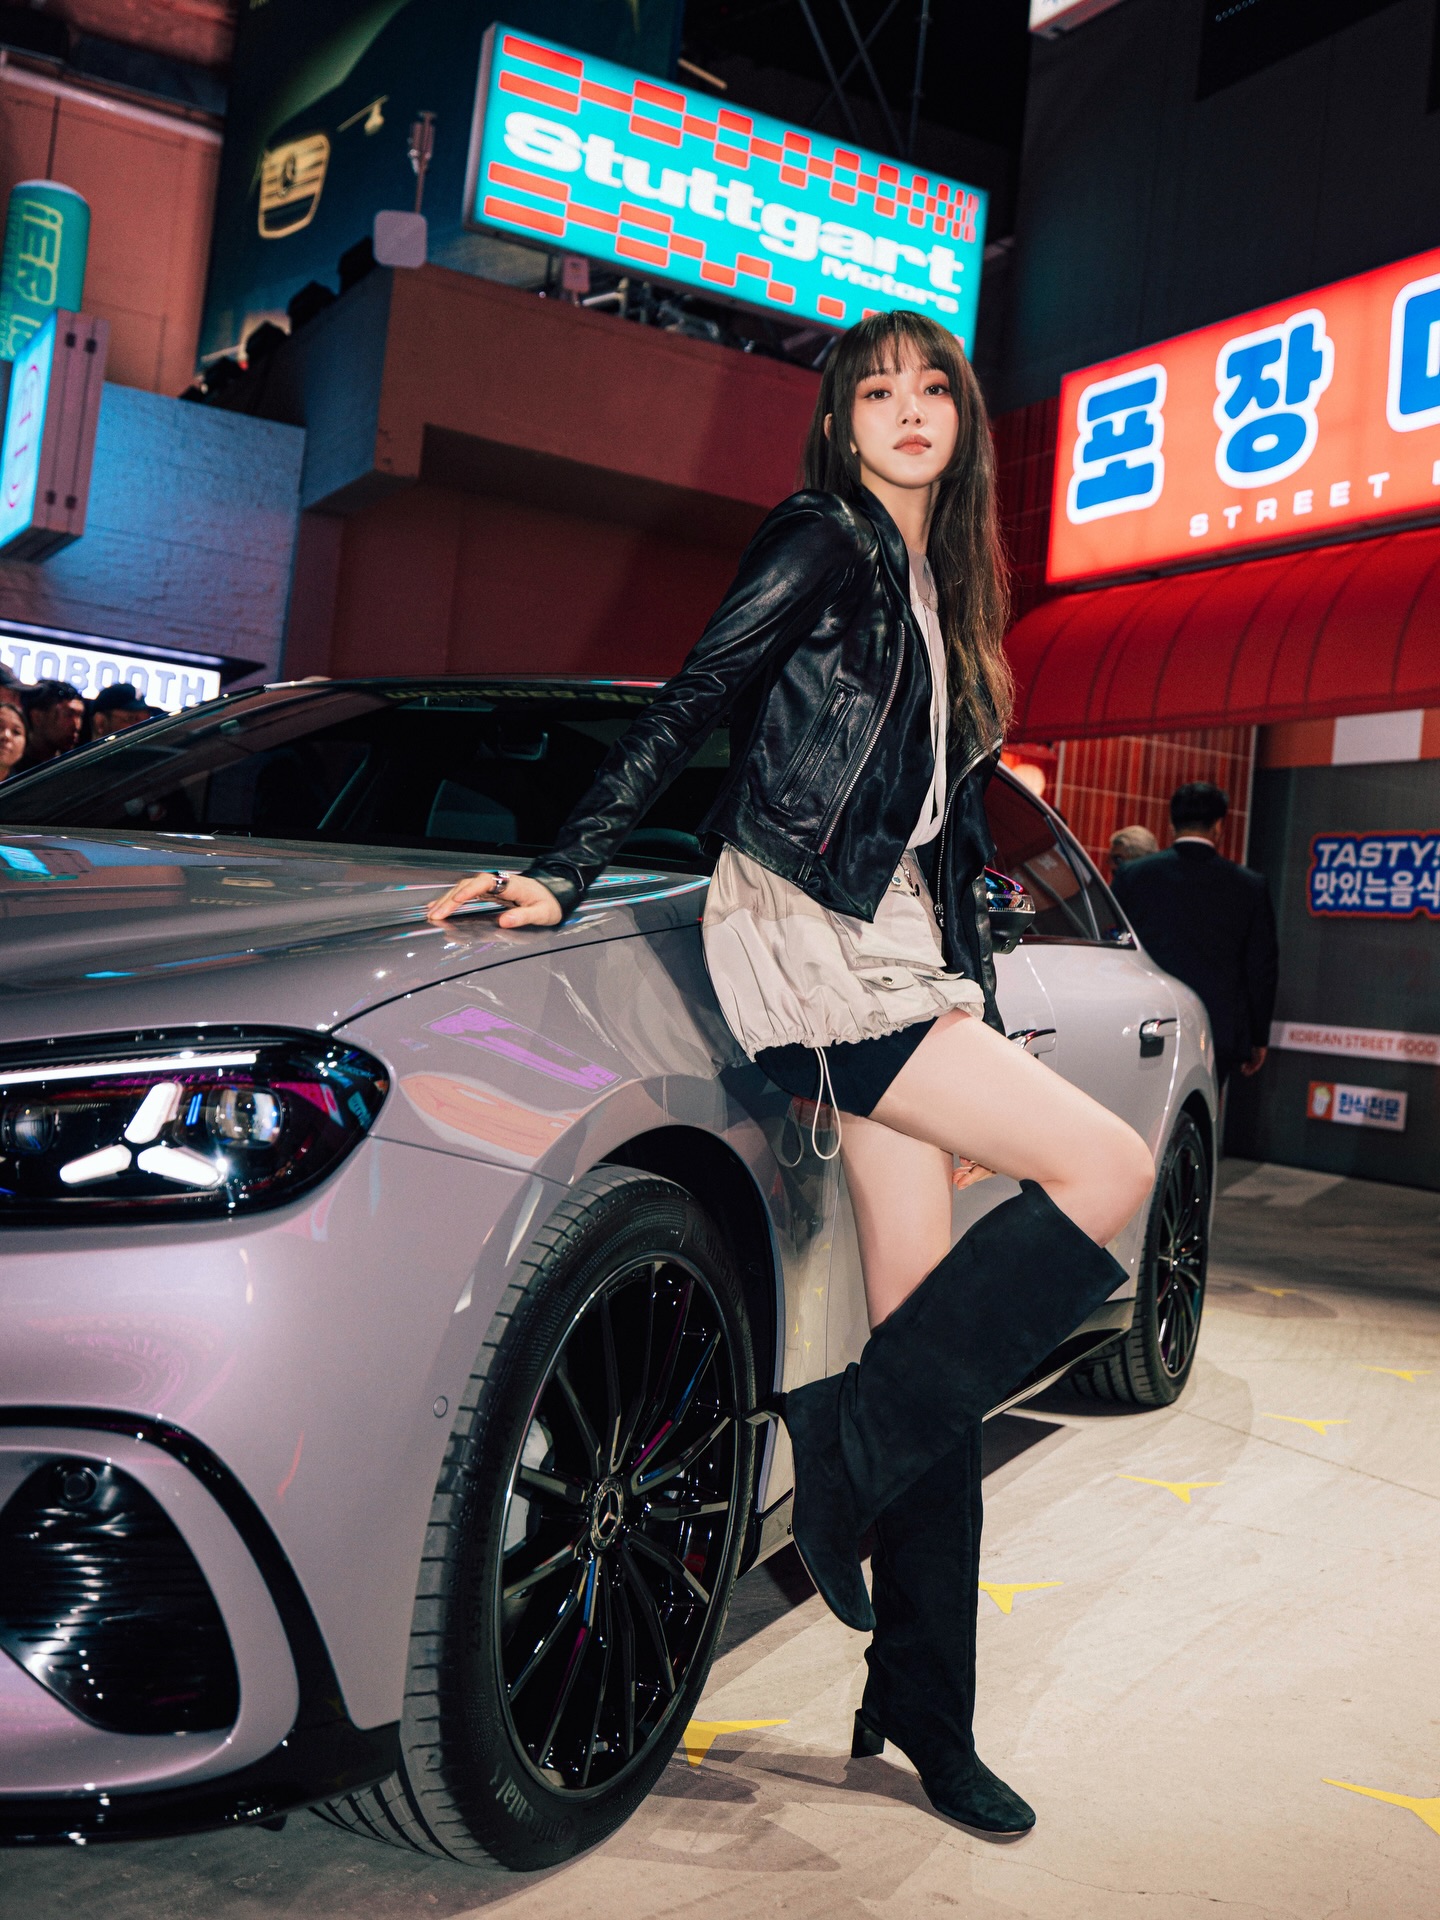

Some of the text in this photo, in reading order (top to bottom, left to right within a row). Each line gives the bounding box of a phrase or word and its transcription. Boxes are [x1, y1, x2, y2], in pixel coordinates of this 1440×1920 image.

[504, 112, 964, 294] Stuttgart
[821, 256, 960, 316] Motors
[1188, 471, 1390, 538] STREET
[0, 643, 206, 707] TOBOOTH
[1317, 841, 1440, 868] TASTY!
[1313, 870, 1440, 908] 맛있는음식
[1288, 1029, 1438, 1057] KOREAN STREET FOOD
